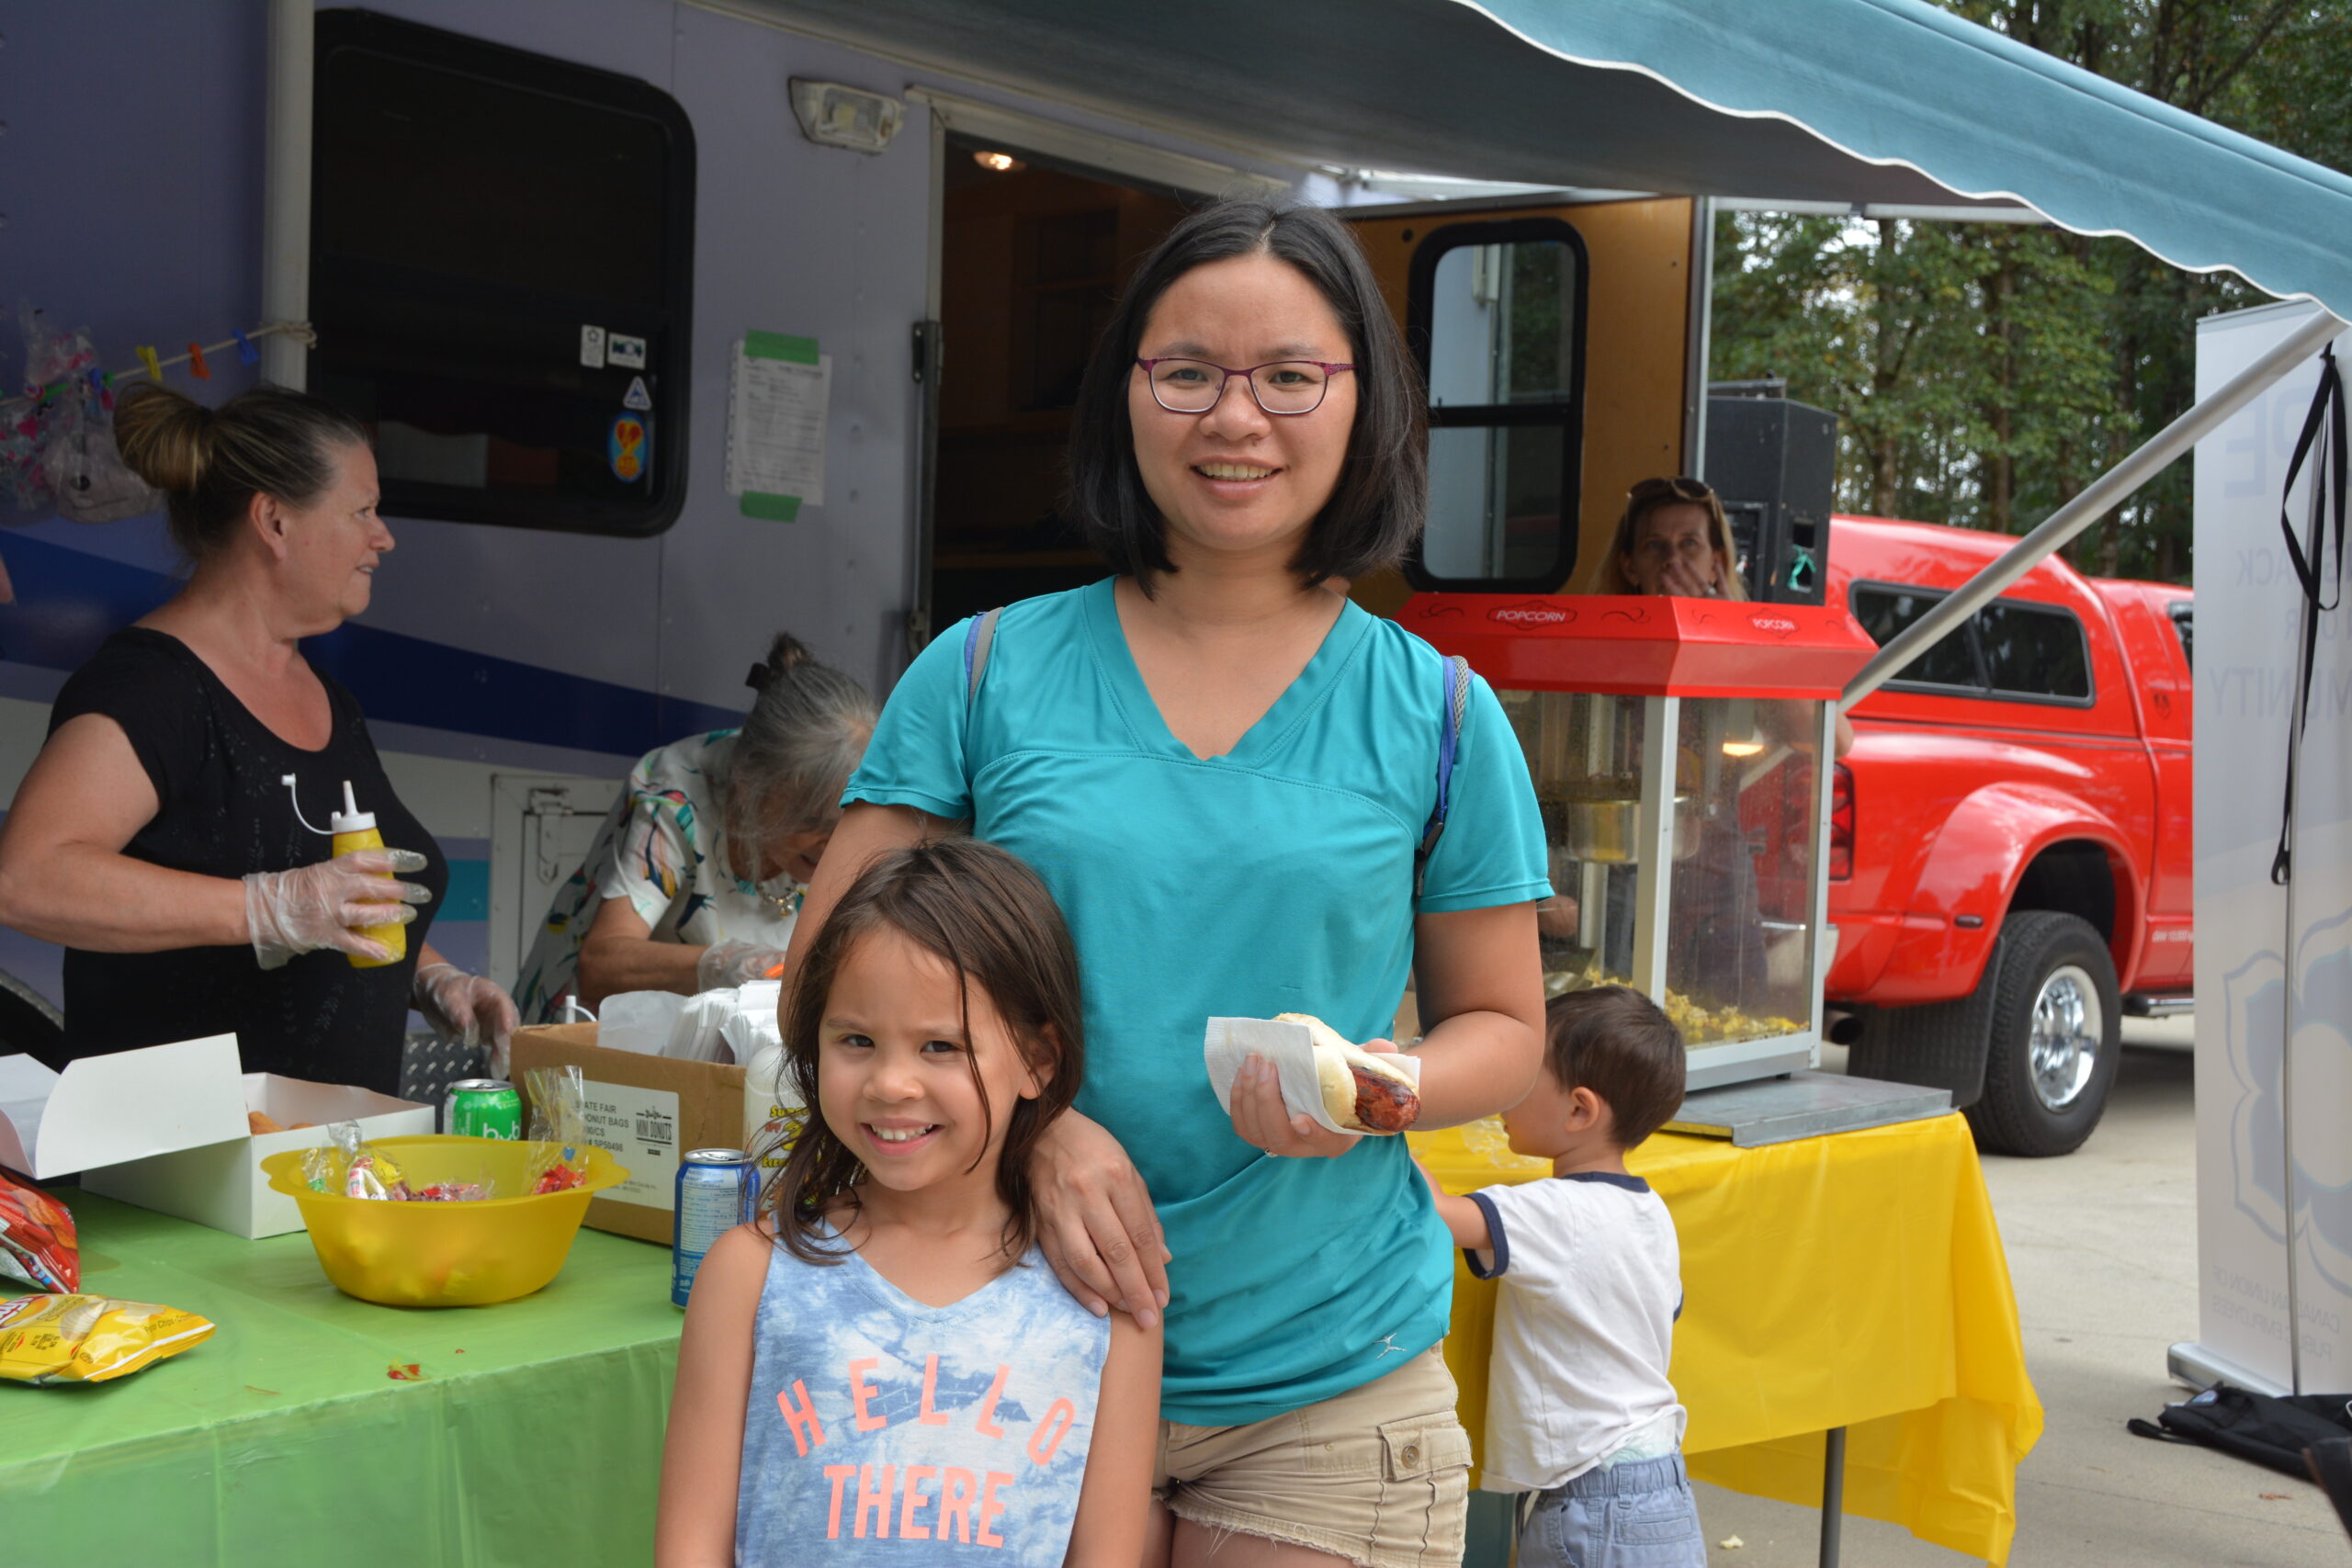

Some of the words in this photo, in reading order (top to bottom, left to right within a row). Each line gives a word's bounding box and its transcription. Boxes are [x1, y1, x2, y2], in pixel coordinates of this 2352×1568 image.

[1495, 610, 1566, 623] POPCORN
[599, 1103, 617, 1115] FAIR
[607, 1116, 629, 1129] BAGS
[636, 1117, 650, 1137] MINI
[650, 1120, 673, 1141] DONUTS
[776, 1354, 1076, 1466] HELLO
[823, 1464, 1014, 1549] THERE
